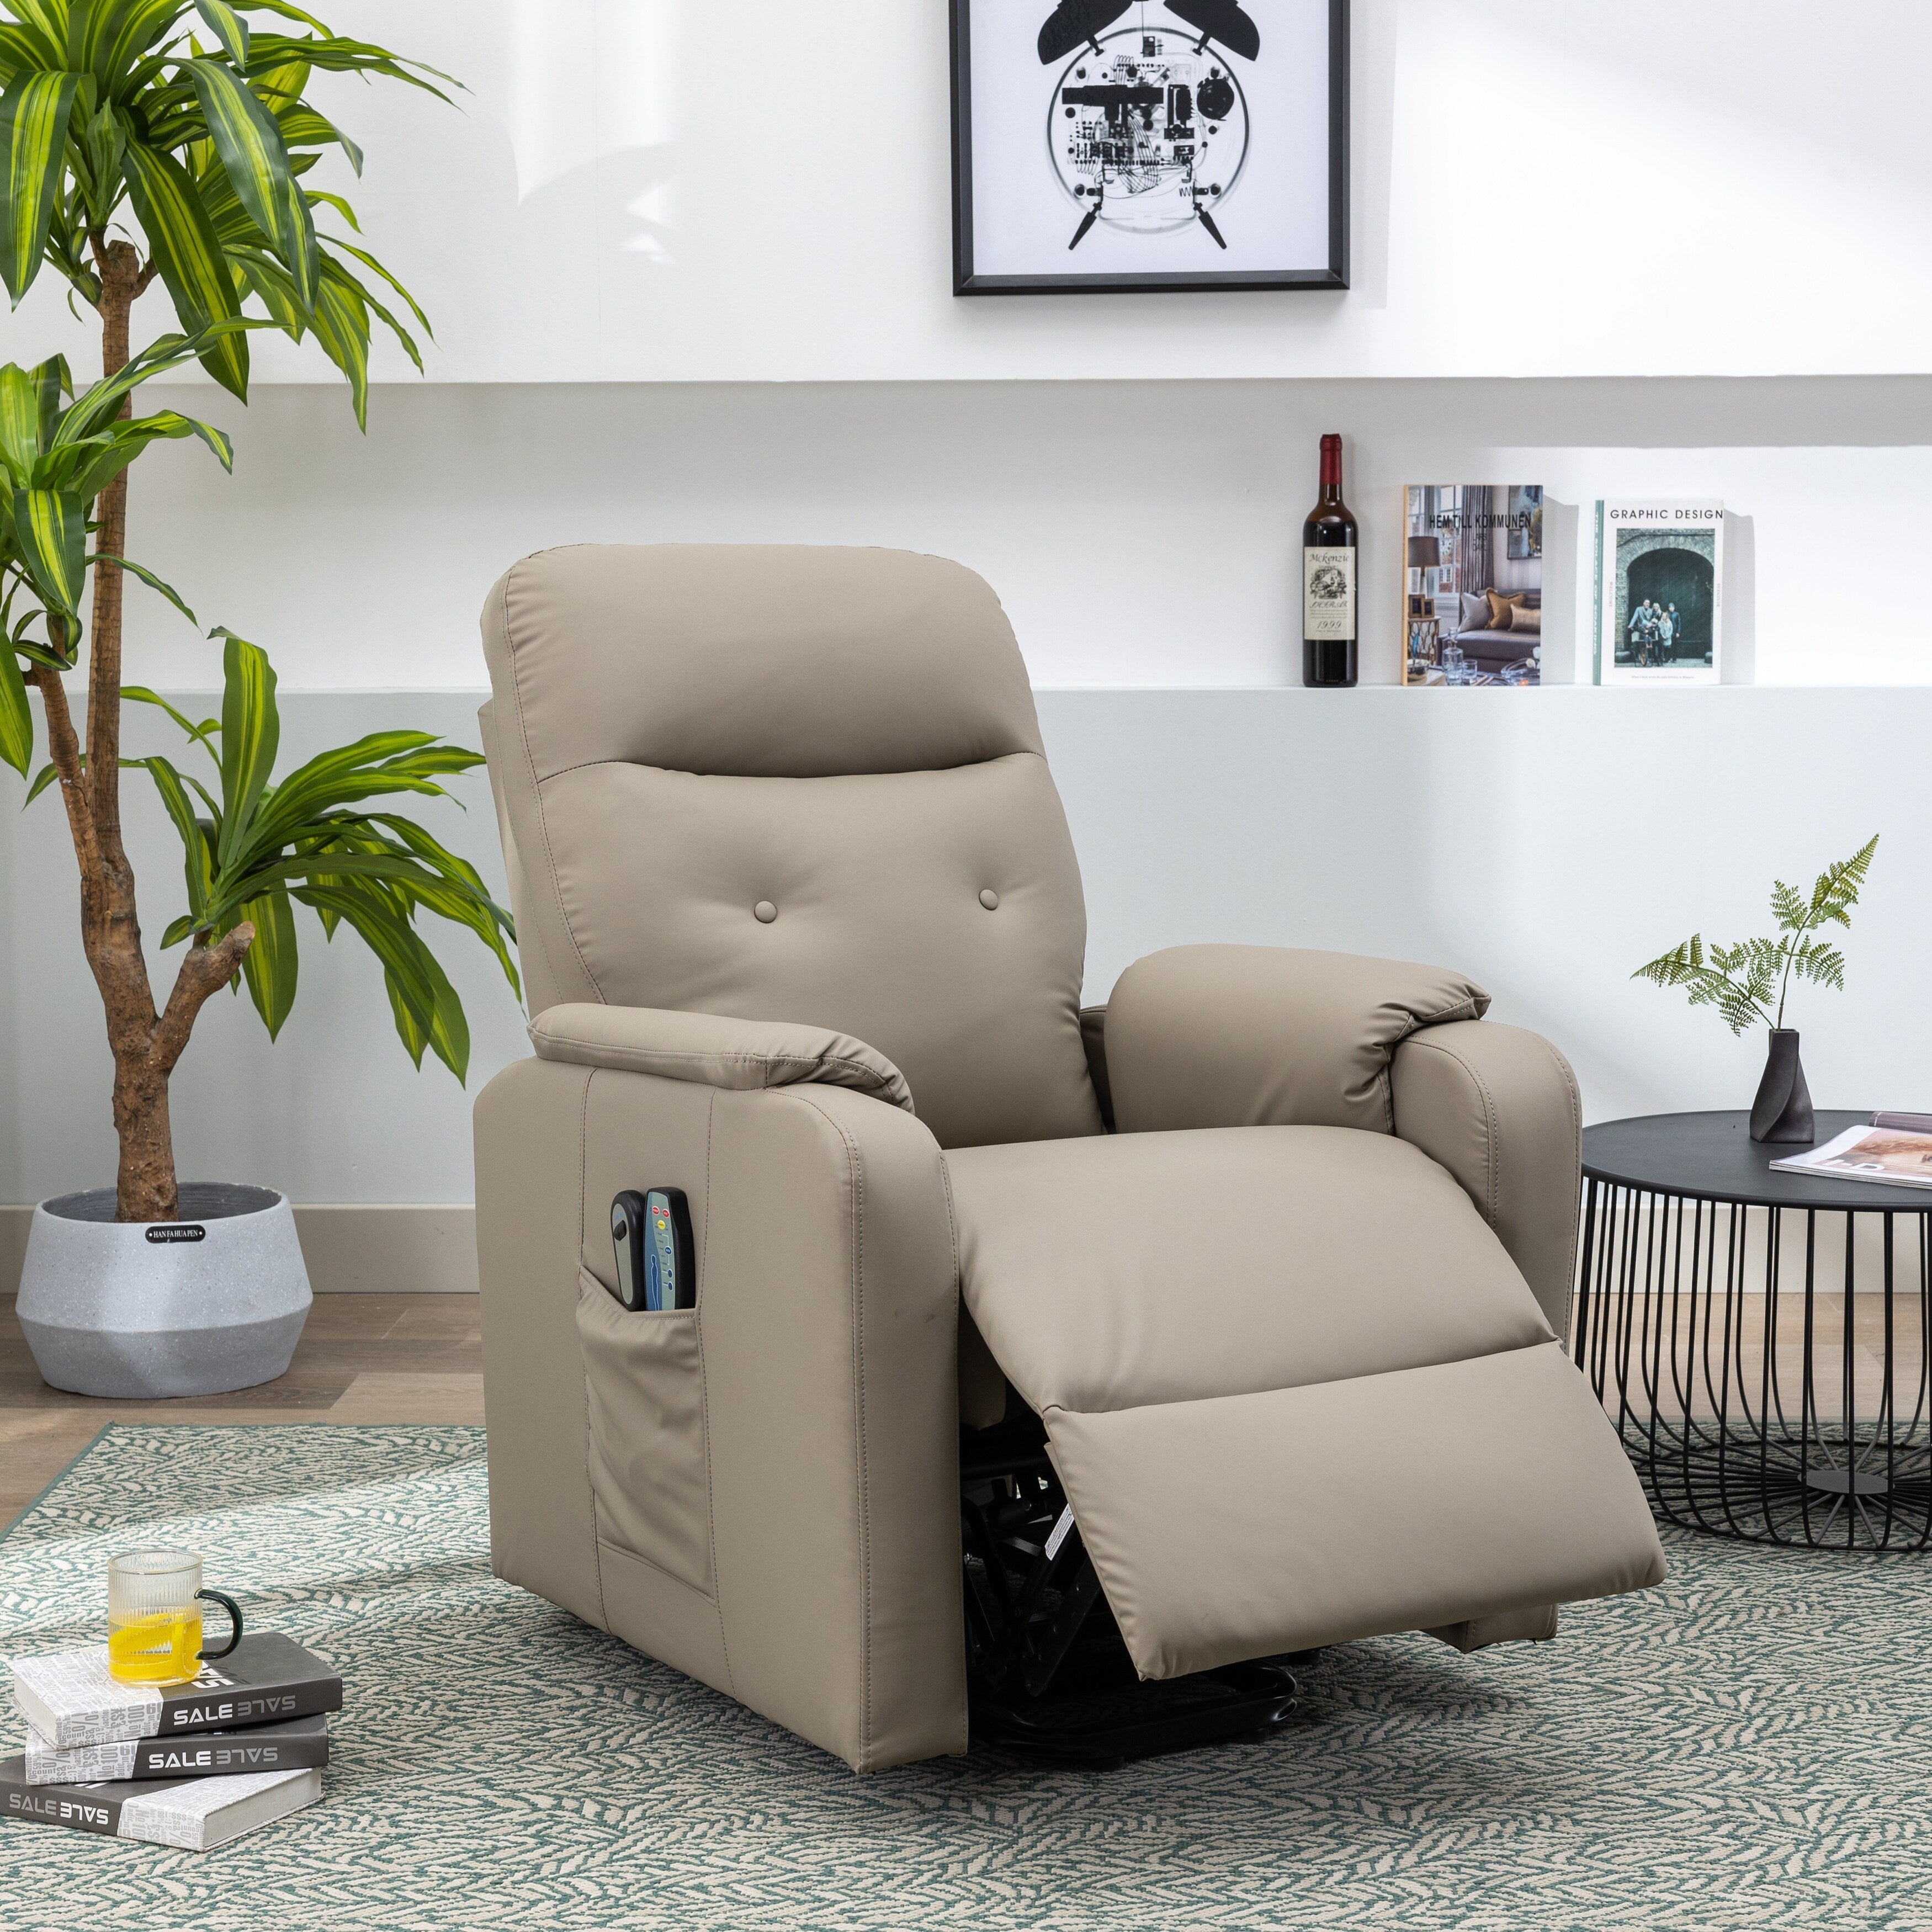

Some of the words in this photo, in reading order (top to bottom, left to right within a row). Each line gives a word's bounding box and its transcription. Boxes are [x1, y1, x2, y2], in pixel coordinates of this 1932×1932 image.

[1430, 514, 1450, 528] HEM
[1453, 514, 1472, 528] TILL
[1475, 514, 1531, 528] KOMMUNEN
[1610, 509, 1668, 519] GRAPHIC
[1675, 509, 1723, 519] DESIGN
[1317, 620, 1341, 629] 1999
[173, 1703, 233, 1726] SALE
[148, 1750, 211, 1769] SALE
[9, 1793, 56, 1816] SALE
